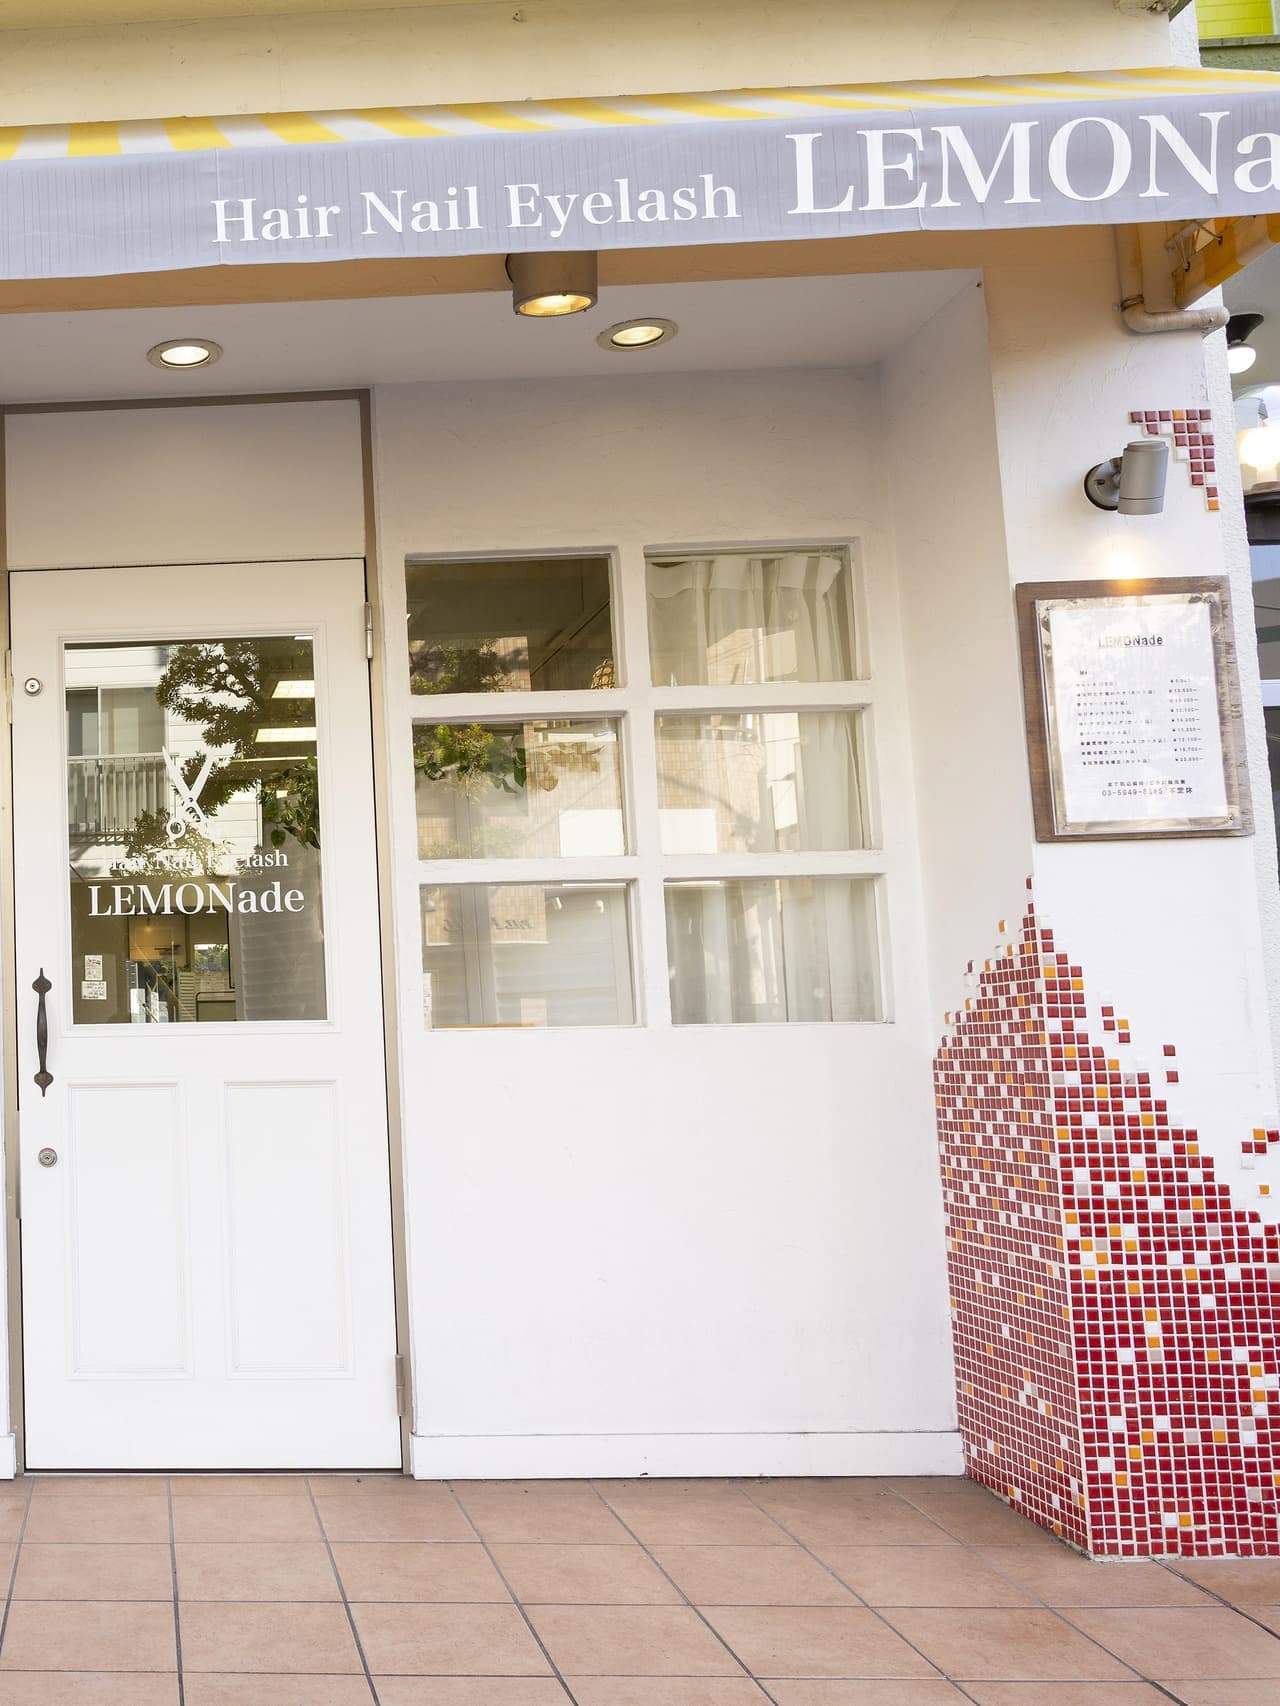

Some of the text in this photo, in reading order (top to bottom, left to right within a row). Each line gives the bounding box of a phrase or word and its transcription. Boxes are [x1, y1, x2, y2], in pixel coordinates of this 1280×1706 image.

[212, 111, 1280, 243] Hair Nail Eyelash LEMONa
[88, 882, 305, 917] LEMONade
